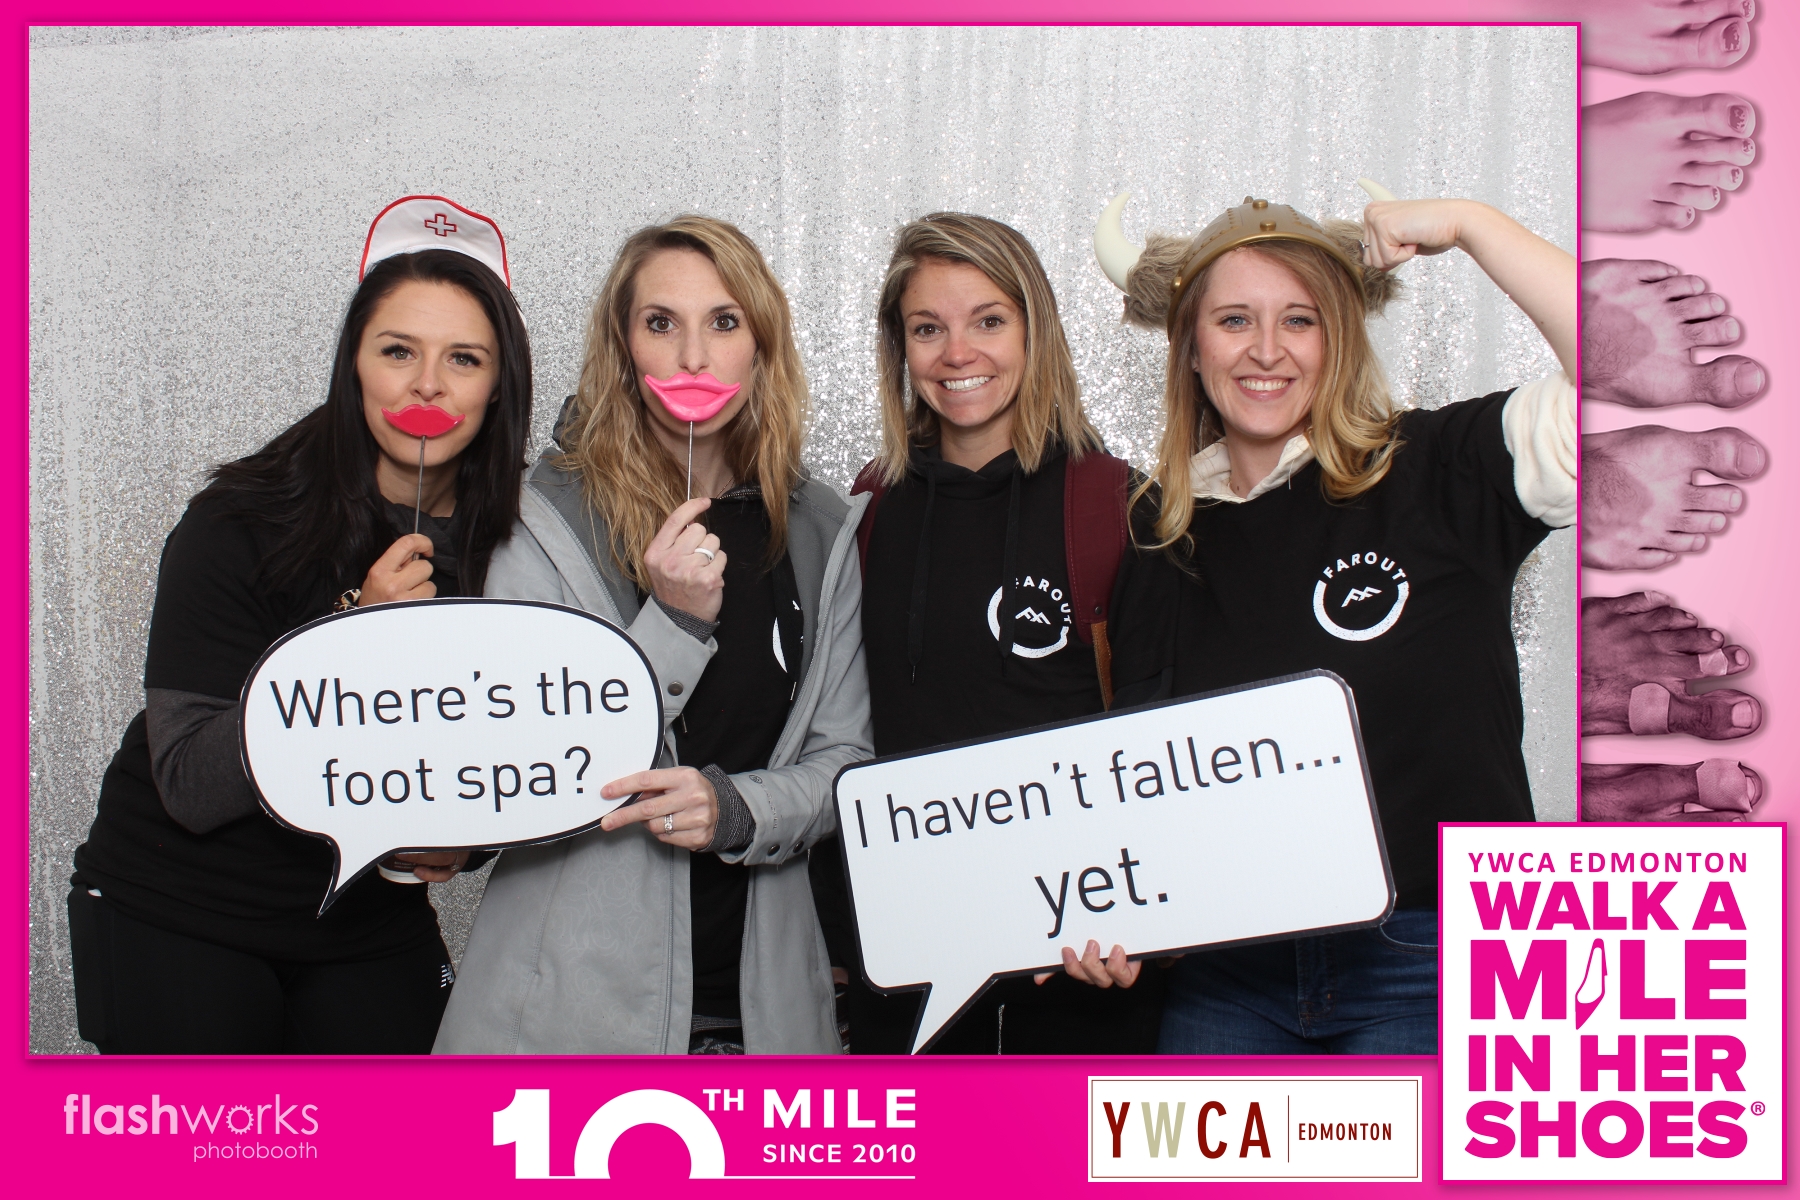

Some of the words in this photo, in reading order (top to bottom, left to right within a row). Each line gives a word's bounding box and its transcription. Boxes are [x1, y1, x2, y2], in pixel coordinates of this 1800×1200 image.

[1323, 551, 1407, 580] FAROUT
[1014, 575, 1072, 625] AROUT
[269, 670, 516, 729] Where's
[537, 667, 629, 716] the
[322, 758, 435, 807] foot
[457, 745, 592, 812] spa?
[855, 799, 868, 848] I
[887, 762, 1093, 843] haven't
[1110, 736, 1342, 803] fallen...
[1034, 847, 1169, 939] yet.
